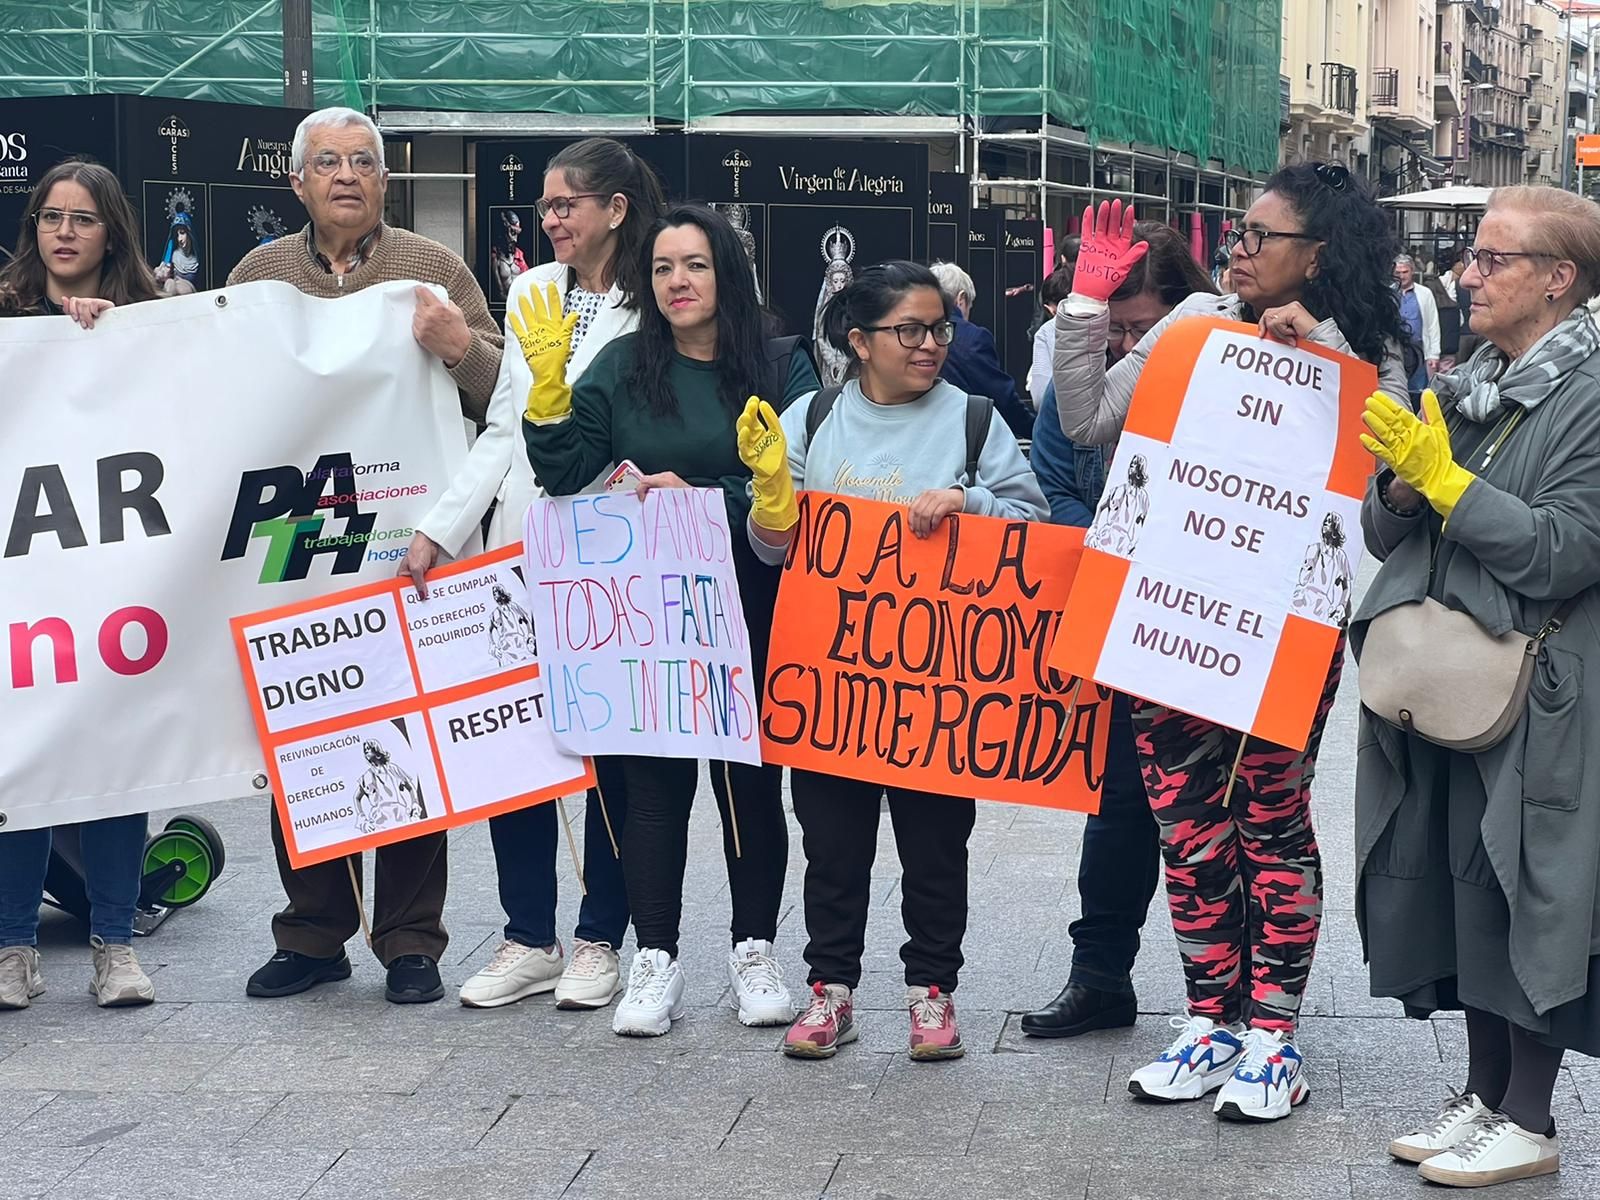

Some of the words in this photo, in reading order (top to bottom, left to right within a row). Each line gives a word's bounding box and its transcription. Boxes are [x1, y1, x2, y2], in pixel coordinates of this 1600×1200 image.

[160, 127, 188, 138] CARAS
[257, 138, 287, 151] Nuestra
[502, 163, 521, 171] CARAS
[724, 159, 749, 167] CARAS
[833, 166, 846, 179] de
[3, 185, 14, 194] DE
[778, 166, 833, 194] Virgen
[836, 180, 846, 191] la
[847, 168, 904, 196] Alegría
[1220, 343, 1323, 391] PORQUE
[1236, 394, 1283, 426] SIN
[305, 460, 401, 482] plataforma
[316, 483, 428, 508] asociaciones
[1168, 458, 1311, 519] NOSOTRAS
[303, 526, 414, 550] trabajadoras
[527, 500, 565, 569] NO
[784, 493, 852, 579] NO
[857, 510, 917, 589] A
[940, 513, 1042, 599] LA
[1183, 510, 1226, 541] NO
[1231, 524, 1265, 554] SE
[433, 587, 446, 599] SE
[447, 573, 498, 595] CUMPLAN
[408, 618, 429, 631] LOS
[431, 602, 486, 628] DERECHOS
[539, 574, 655, 651] TODAS
[661, 572, 744, 650] FALTAN
[1135, 576, 1232, 627] MUEVE
[1236, 609, 1264, 639] EL
[249, 608, 386, 661] TRABAJO
[418, 622, 486, 649] ADQUIRIDOS
[1132, 622, 1242, 677] MUNDO
[262, 664, 364, 710] DIGNO
[548, 662, 613, 734] LAS
[620, 658, 753, 742] INTERNAS
[762, 662, 1106, 792] SUMERGIDA
[279, 734, 361, 764] REIVINDICACIÓN
[310, 766, 324, 777] DE
[287, 780, 345, 805] DERECHOS
[294, 806, 354, 831] HUMANOS
